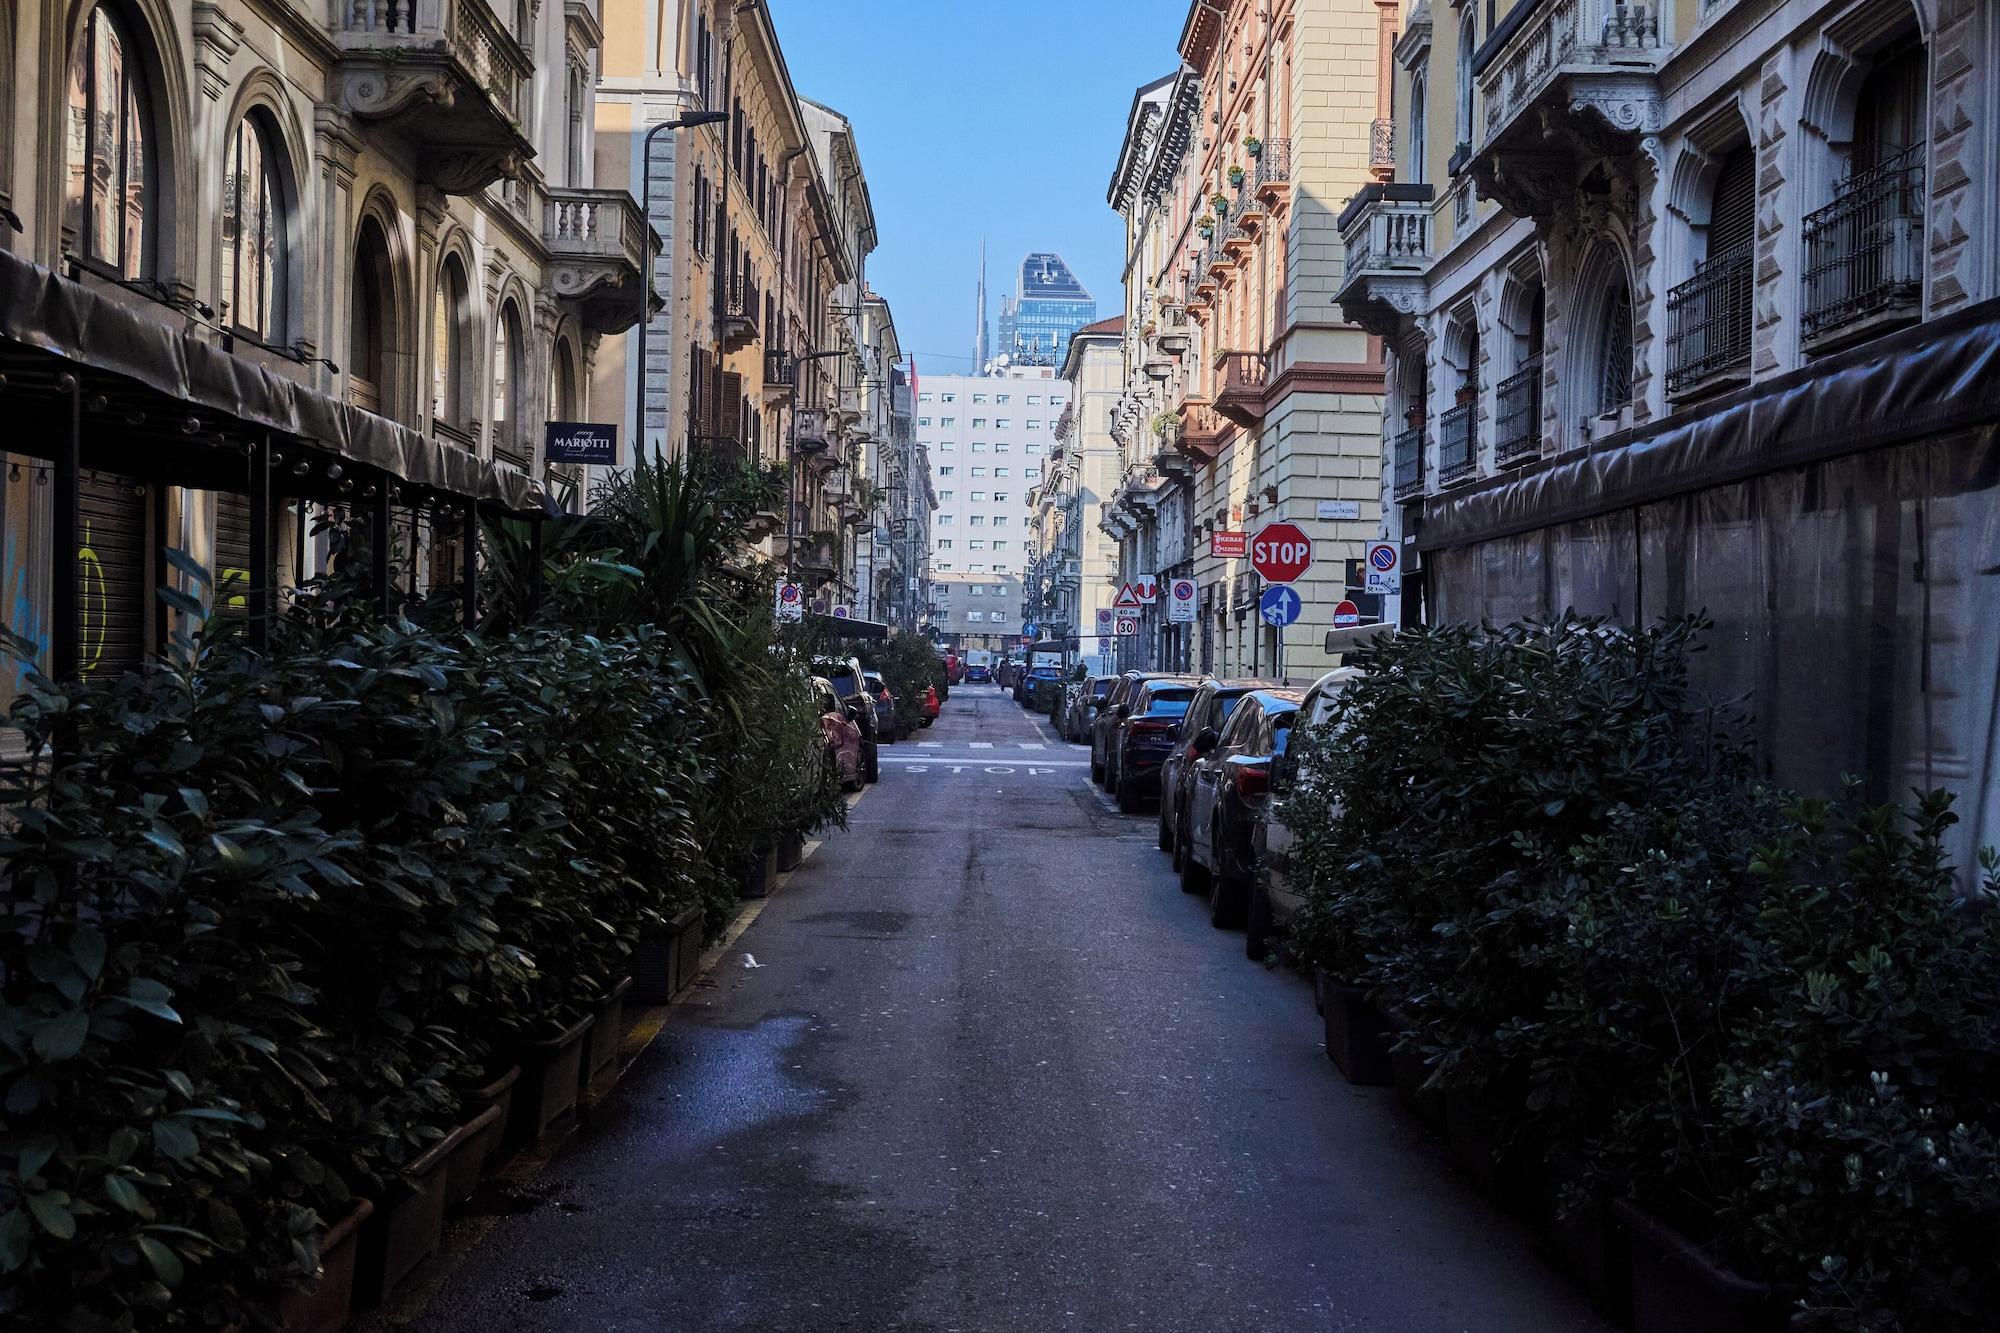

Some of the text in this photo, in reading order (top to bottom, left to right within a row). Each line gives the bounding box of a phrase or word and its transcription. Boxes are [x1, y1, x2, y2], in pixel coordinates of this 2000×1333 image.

[554, 438, 609, 448] MARIOTTI
[1255, 542, 1308, 564] STOP
[1120, 623, 1133, 633] 30
[905, 765, 1056, 775] STOP
